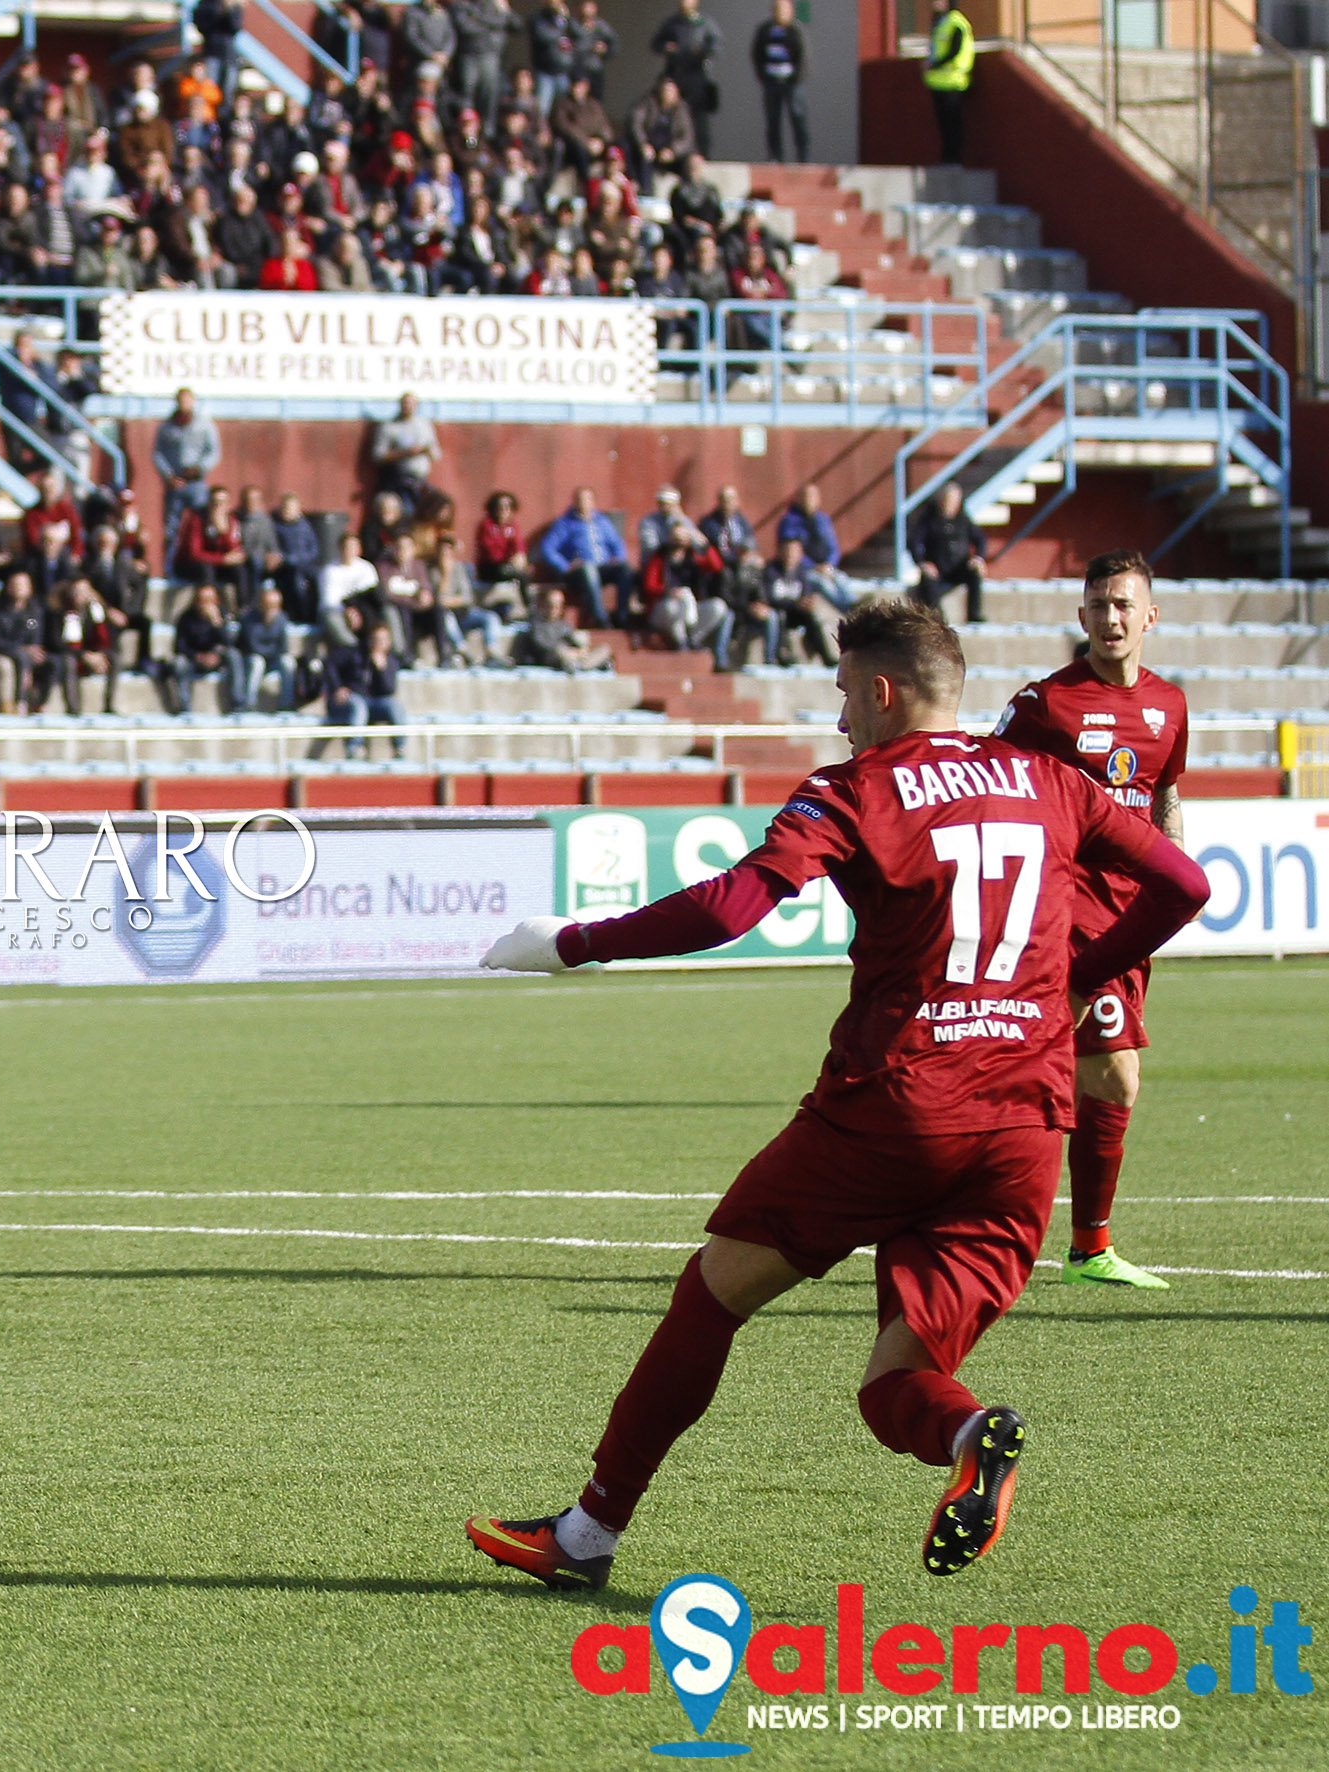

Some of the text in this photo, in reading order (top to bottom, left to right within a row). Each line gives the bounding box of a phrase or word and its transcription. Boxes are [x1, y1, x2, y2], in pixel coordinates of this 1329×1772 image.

[142, 308, 619, 352] CLUB VILLA ROSINA
[143, 352, 619, 387] INSIEME PER IL TRAPANI CALCIO
[258, 871, 508, 919] Banca Nuova
[929, 822, 1045, 985] 17
